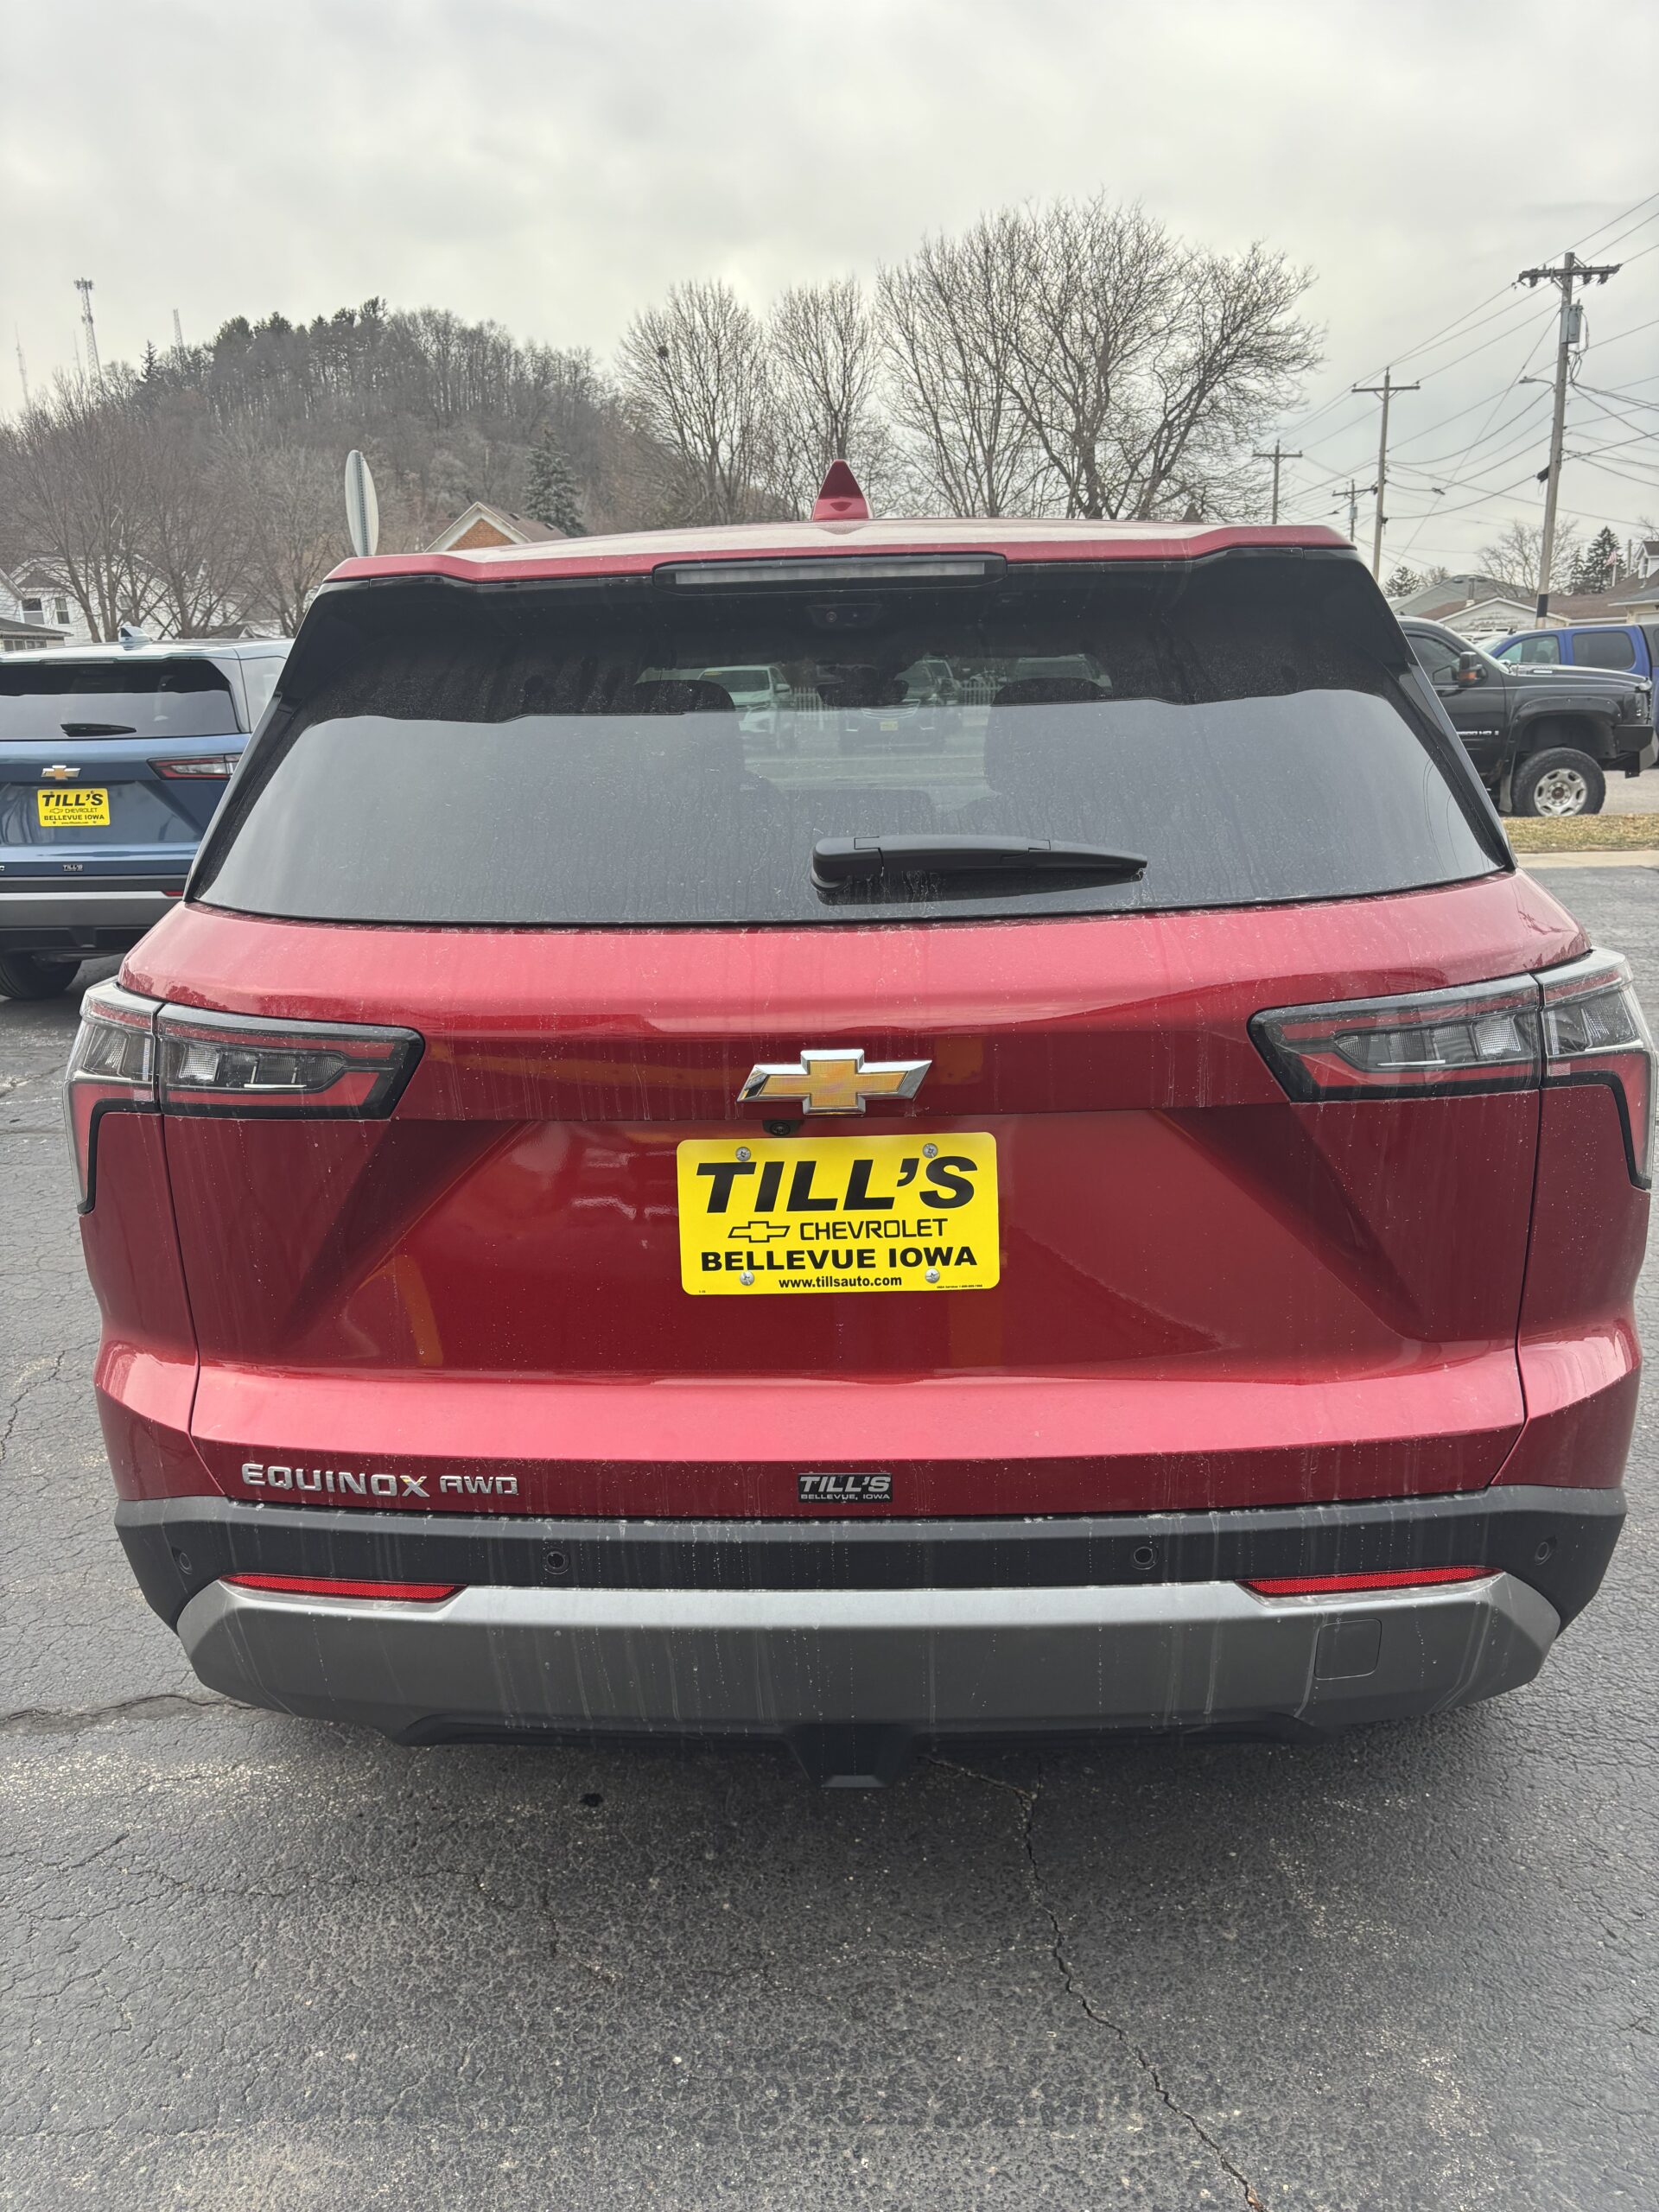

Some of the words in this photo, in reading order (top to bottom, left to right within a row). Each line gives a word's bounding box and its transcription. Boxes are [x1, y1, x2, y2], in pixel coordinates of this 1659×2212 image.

[41, 793, 104, 807] TILL'S
[696, 1155, 978, 1213] TILL'S
[799, 1217, 949, 1241] CHEVROLET
[701, 1248, 876, 1272] BELLEVUE
[888, 1246, 977, 1268] IOWA
[779, 1275, 902, 1287] www.tillsauto.com
[241, 1463, 430, 1497] EQUINOX
[439, 1474, 519, 1496] AWD
[799, 1476, 892, 1492] TILL'S
